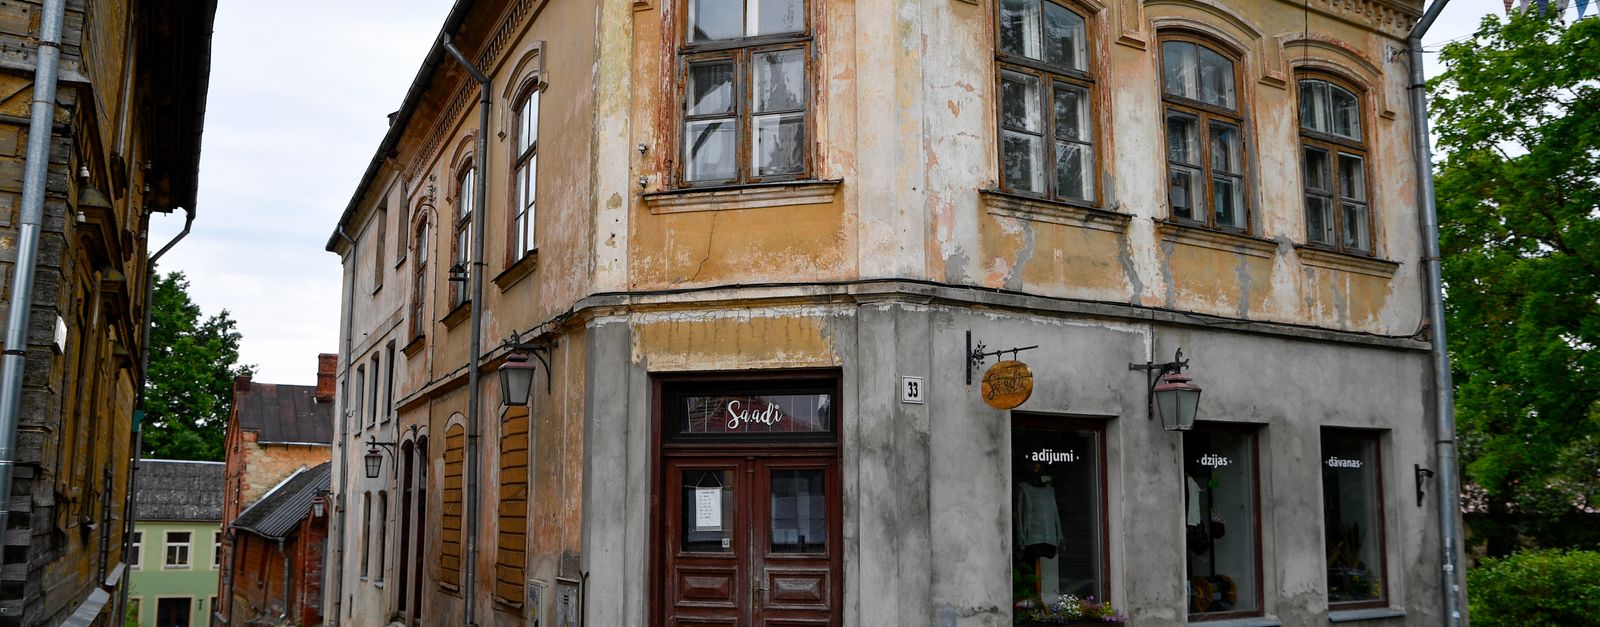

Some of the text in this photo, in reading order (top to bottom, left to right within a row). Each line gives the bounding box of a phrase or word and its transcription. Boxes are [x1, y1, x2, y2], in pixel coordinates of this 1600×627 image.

[908, 381, 918, 398] 33
[1032, 448, 1074, 465] adījumi
[1201, 453, 1228, 469] dzijas
[1328, 456, 1360, 468] dāvanas
